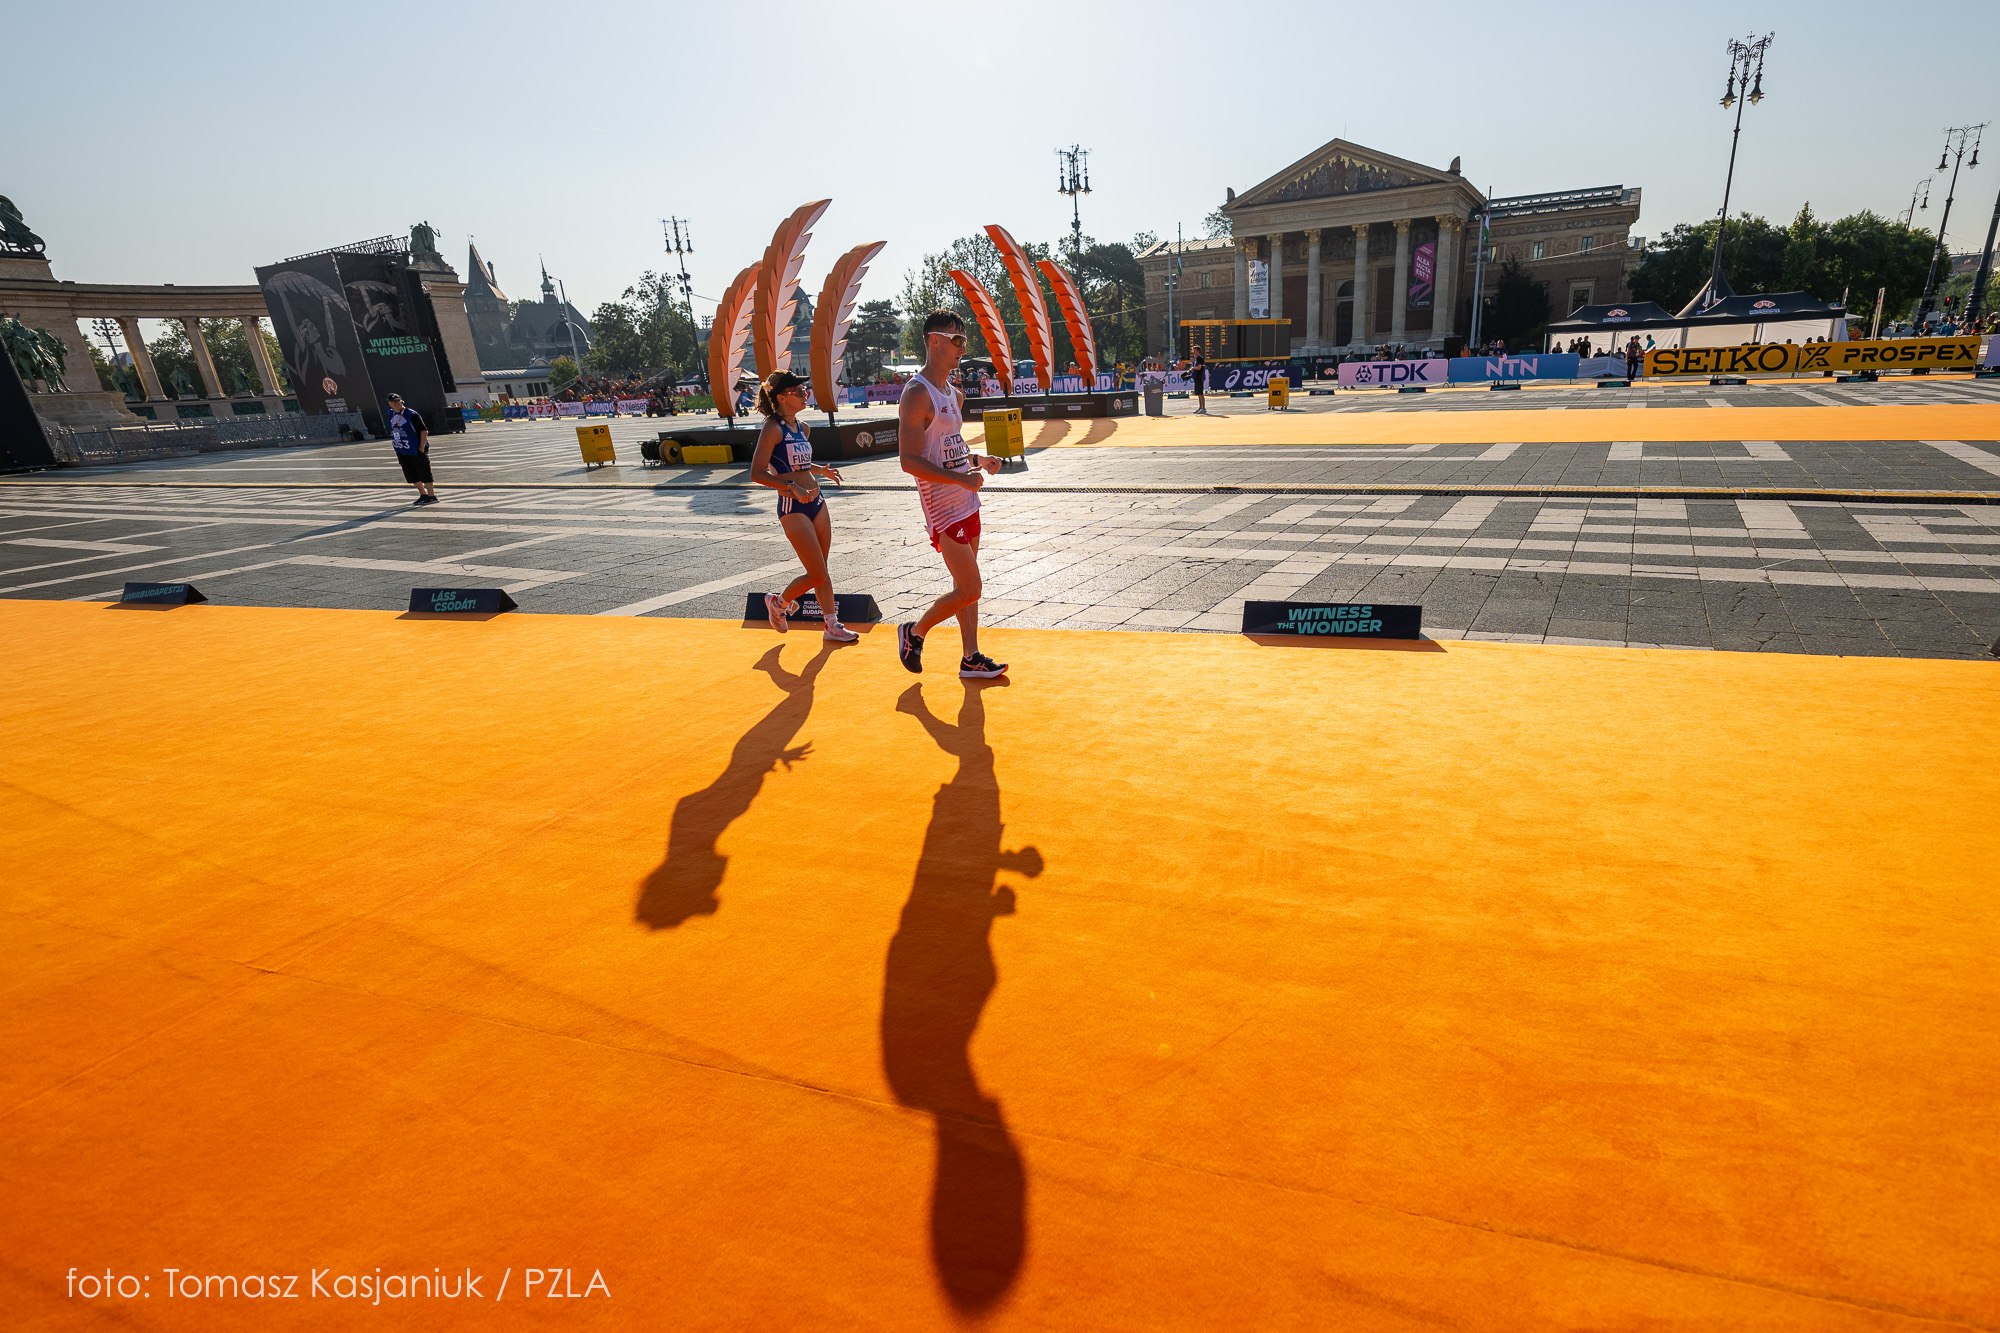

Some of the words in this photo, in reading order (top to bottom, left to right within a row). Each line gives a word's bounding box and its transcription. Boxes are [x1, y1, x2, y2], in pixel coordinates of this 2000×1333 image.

[369, 336, 420, 348] WITNESS
[378, 344, 428, 356] WONDER
[1843, 344, 1978, 364] PROSPEX
[1652, 346, 1789, 374] SEIKO
[1372, 362, 1430, 382] TDK
[1486, 357, 1538, 378] NTN
[950, 434, 965, 446] TD
[124, 584, 184, 601] #WABUDAPEST23
[431, 590, 456, 602] LÁSS
[434, 598, 476, 612] CSODÁT!
[1288, 606, 1373, 621] WITNESS
[1297, 620, 1383, 634] WONDER
